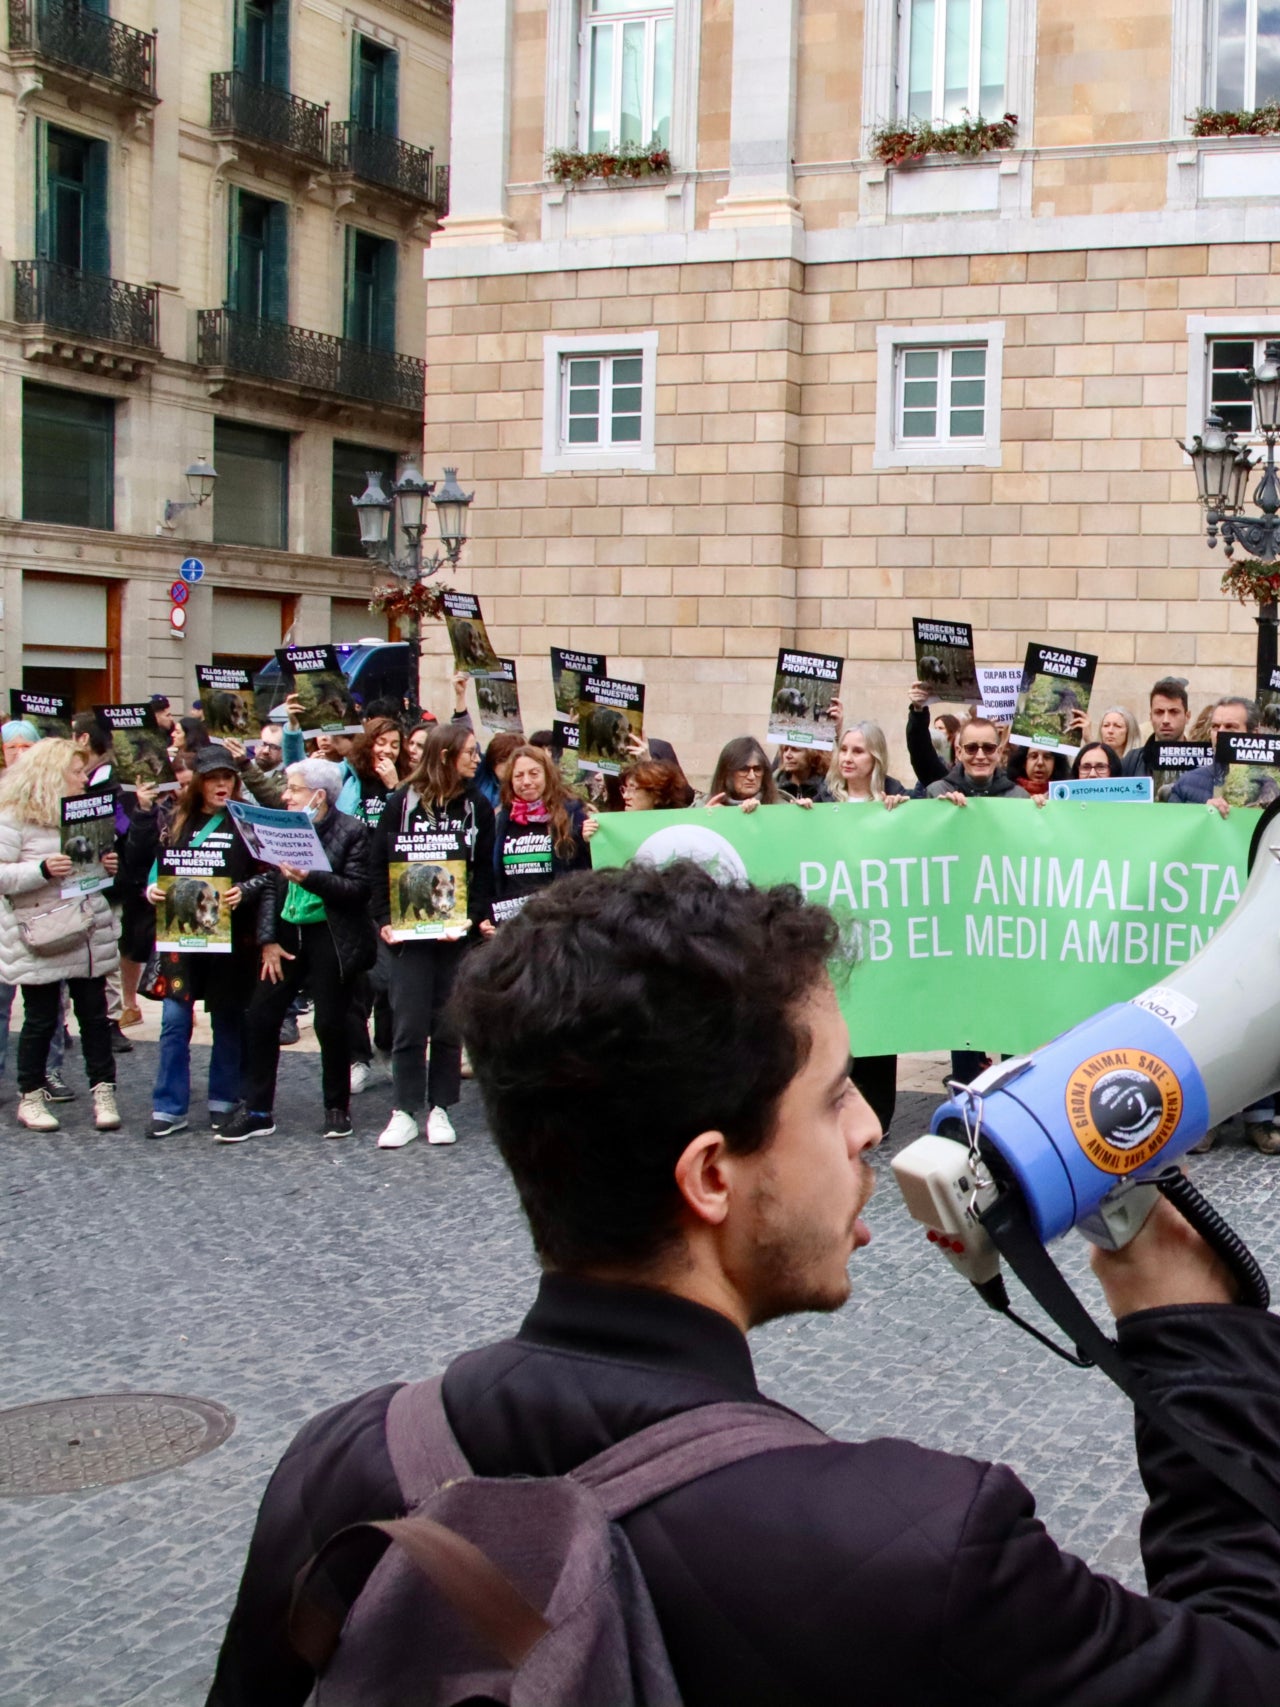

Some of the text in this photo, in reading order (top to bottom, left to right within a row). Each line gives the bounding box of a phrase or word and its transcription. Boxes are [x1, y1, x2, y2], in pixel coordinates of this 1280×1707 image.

[918, 622, 968, 636] MERECEN SU
[918, 631, 970, 646] PROPIA VIDA
[286, 649, 328, 661] CAZAR ES
[560, 652, 598, 665] CAZAR ES
[784, 653, 838, 669] MERECEN SU
[1038, 649, 1088, 668] CAZAR ES
[294, 659, 325, 670] MATAR
[564, 661, 593, 672] MATAR
[1042, 661, 1079, 678] MATAR
[202, 667, 245, 677] ELLOS PAGAN
[781, 662, 838, 680] PROPIA VIDA
[983, 670, 1022, 679] CULPAR ELS
[212, 675, 249, 683] NUESTROS
[588, 677, 637, 693] ELLOS PAGAN
[210, 681, 240, 690] ERRORES
[585, 685, 640, 701] POR NUESTROS
[20, 694, 64, 707] CAZAR ES
[594, 694, 628, 708] ERRORES
[26, 703, 57, 716] MATAR
[104, 708, 146, 717] CAZAR ES
[112, 717, 144, 727] MATAR
[1230, 737, 1266, 749] CAZAR
[1160, 747, 1204, 756] MERECEN
[1236, 749, 1274, 762] MATAR
[1159, 757, 1195, 766] PROPIA
[1071, 786, 1130, 795] #STOPMATANÇA
[66, 793, 113, 811] MERECEN SU
[65, 804, 114, 821] PROPIA VIDA
[397, 834, 456, 843] ELLOS PAGAN
[395, 842, 459, 852] POR NUESTROS
[166, 850, 223, 859] ELLOS PAGAN
[407, 851, 447, 860] ERRORES
[163, 858, 226, 867] POR NUESTROS
[175, 866, 214, 875] ERRORES
[800, 855, 1241, 917] PARTIT ANIMALISTA
[908, 916, 953, 960] EL
[964, 914, 1048, 960] MEDI
[1060, 920, 1213, 967] AMBIEN
[1071, 1052, 1168, 1128] GIRONA ANIMAL SAVE
[1086, 1090, 1178, 1169] ANIMAL SAVE MOVEMENT
